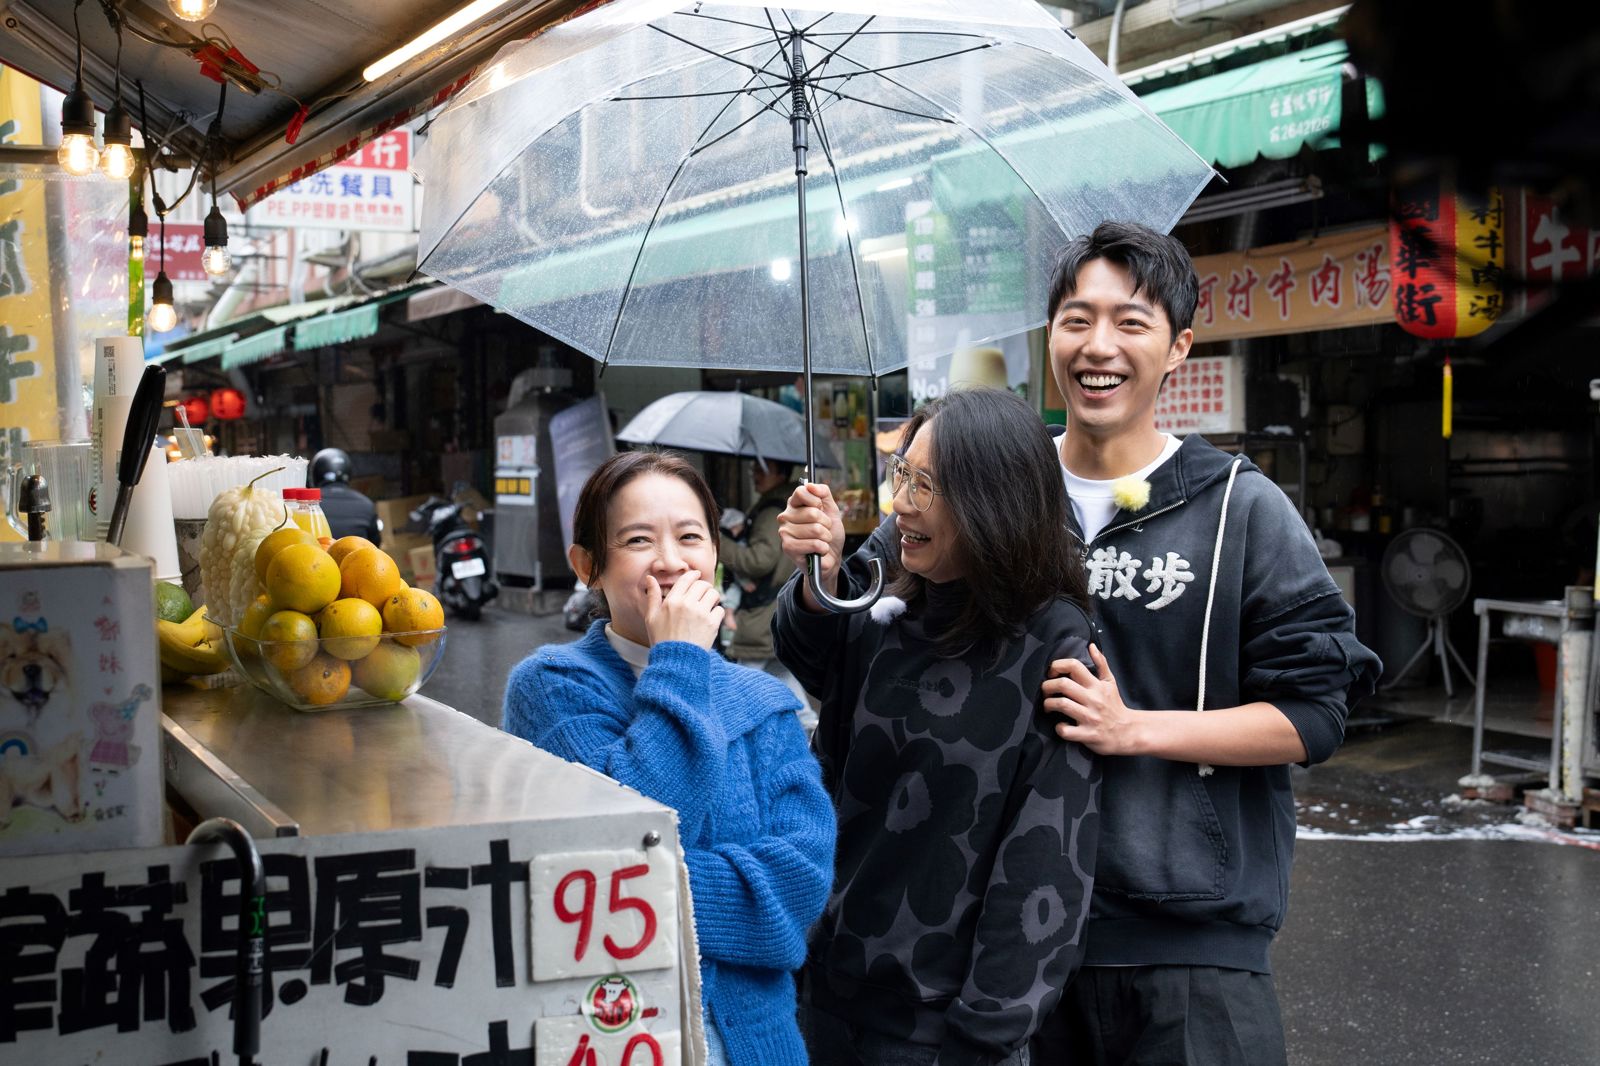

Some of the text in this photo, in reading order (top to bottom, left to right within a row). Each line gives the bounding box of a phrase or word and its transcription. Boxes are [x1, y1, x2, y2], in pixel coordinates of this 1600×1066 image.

[353, 134, 401, 168] 行
[1531, 206, 1600, 278] 牛
[1086, 545, 1195, 610] 散步
[553, 864, 658, 962] 95
